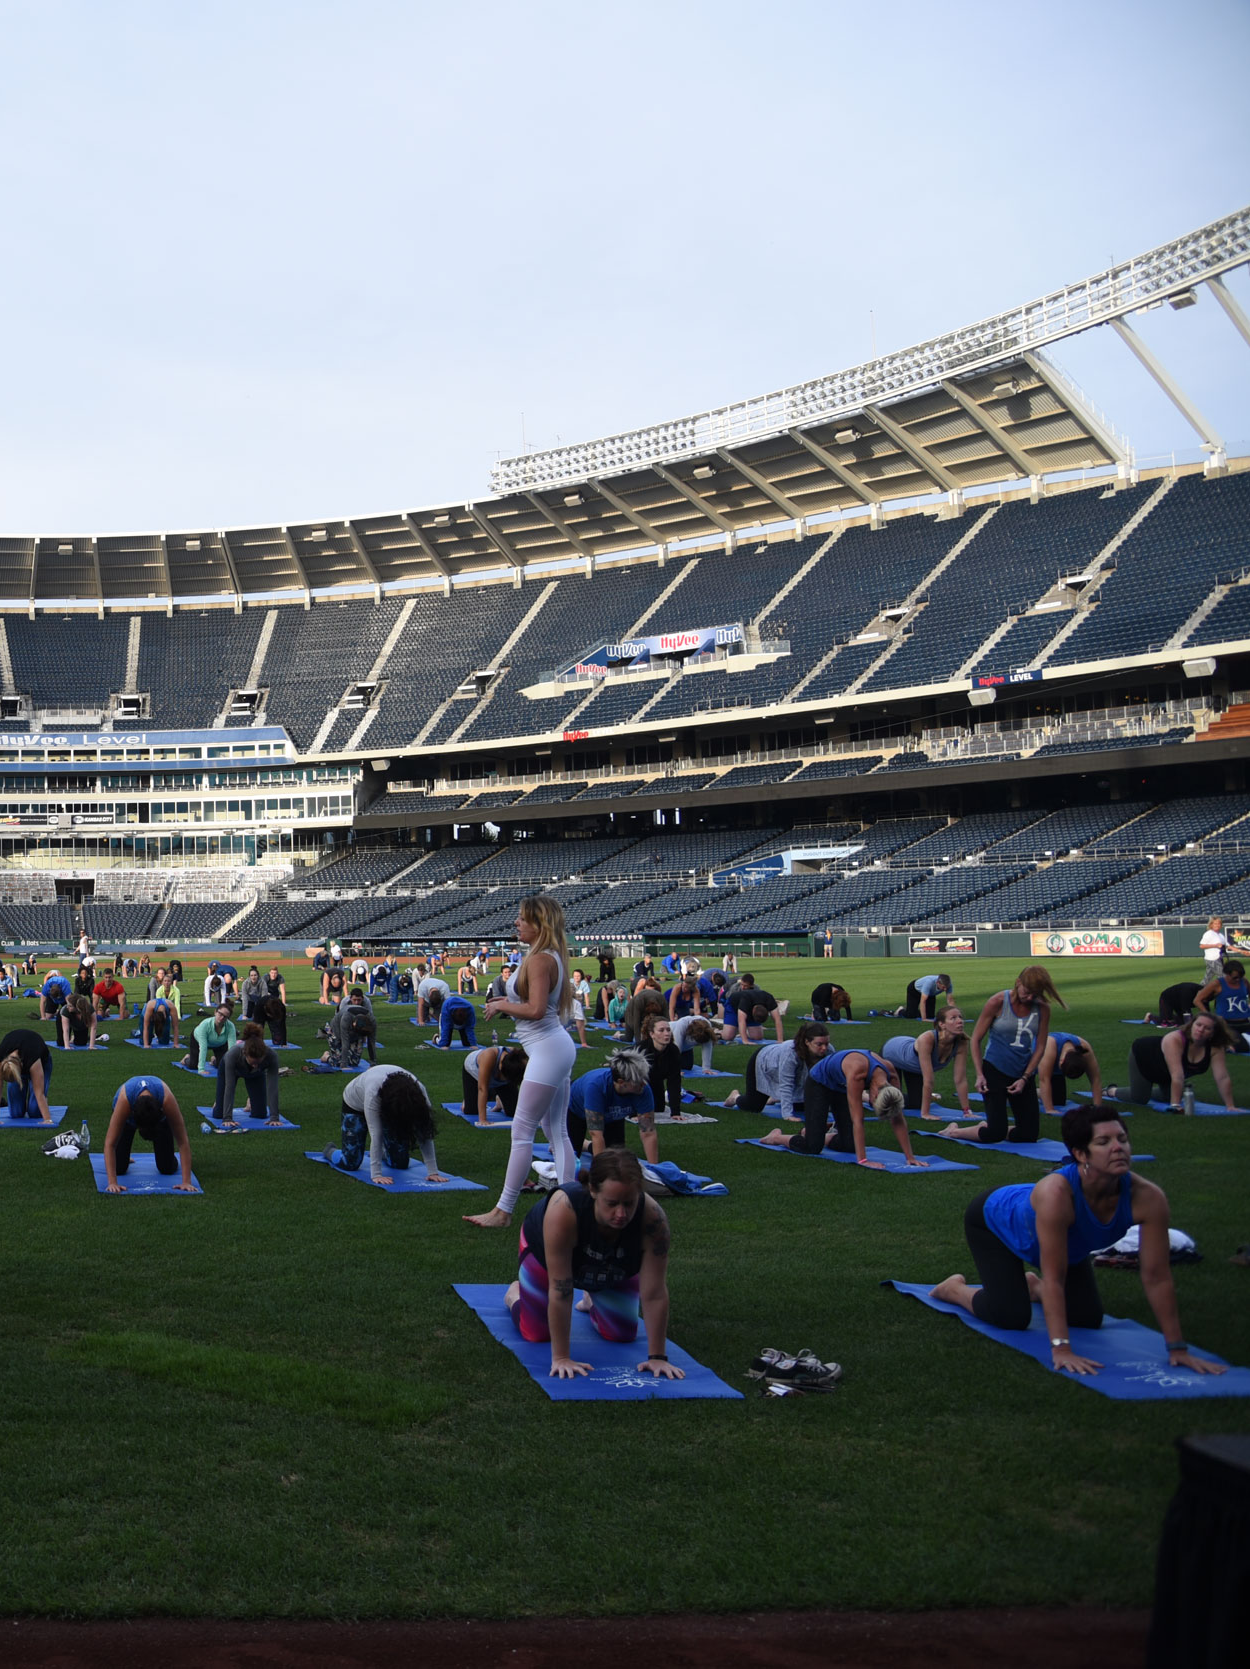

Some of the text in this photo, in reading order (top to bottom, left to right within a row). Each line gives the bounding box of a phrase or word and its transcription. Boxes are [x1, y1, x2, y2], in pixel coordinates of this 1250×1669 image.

[660, 633, 699, 650] HyVee
[1010, 673, 1033, 683] LEVEL
[83, 734, 146, 745] Level
[1069, 933, 1122, 948] ROMA
[1226, 996, 1249, 1013] KC
